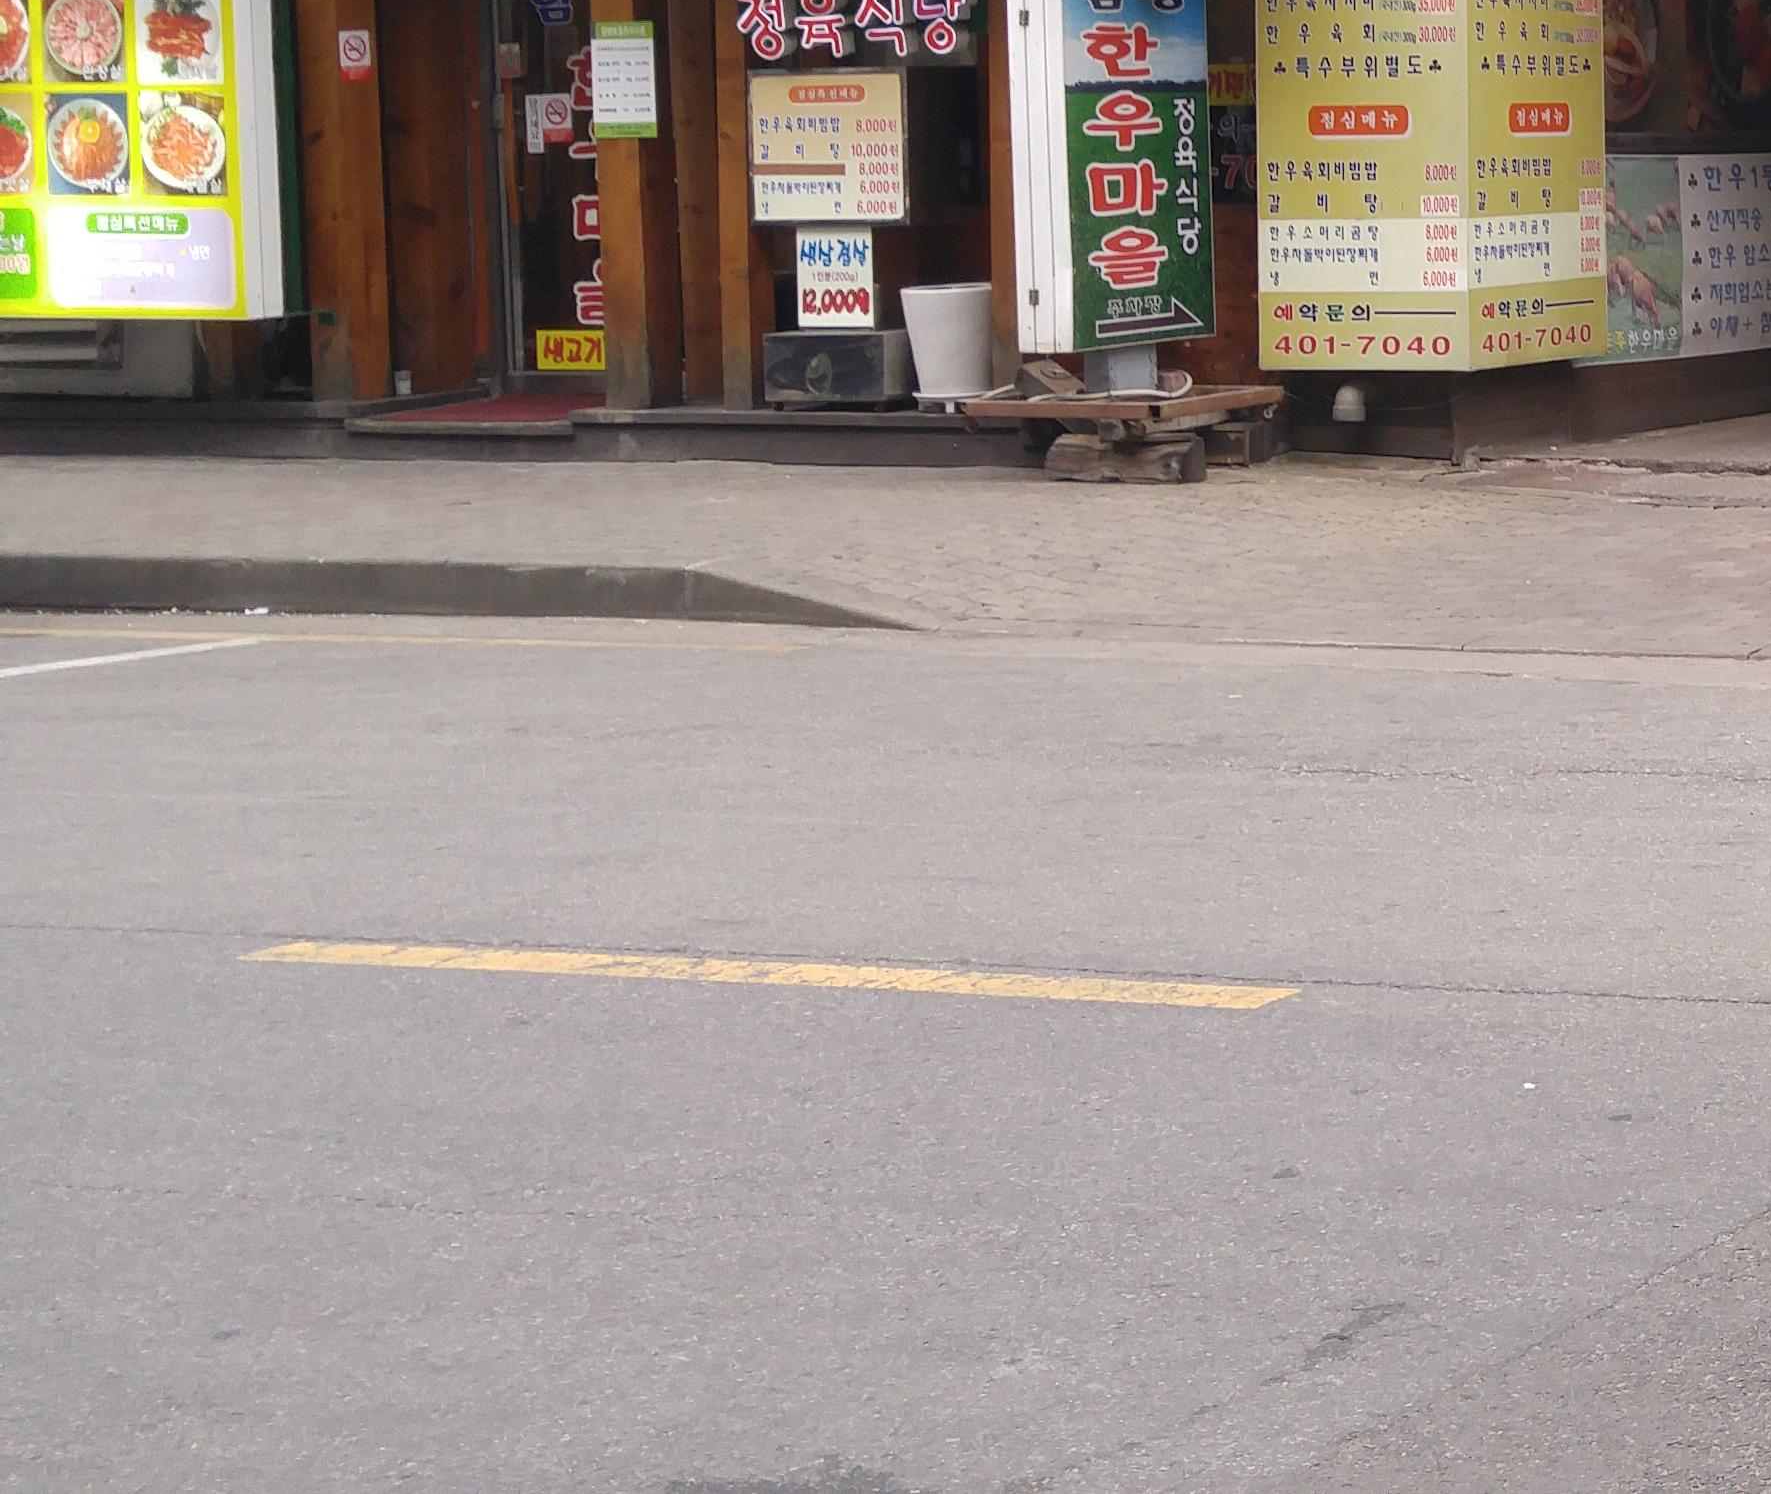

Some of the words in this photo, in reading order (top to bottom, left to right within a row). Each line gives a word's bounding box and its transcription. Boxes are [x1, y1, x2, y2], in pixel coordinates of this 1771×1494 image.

[1081, 22, 1168, 291] 한우마을
[1173, 97, 1200, 255] 정육식당
[1274, 304, 1371, 322] 예약문의
[1481, 298, 1544, 320] 예약문의
[1275, 335, 1451, 356] 401-7040
[1482, 323, 1592, 354] 401-7040
